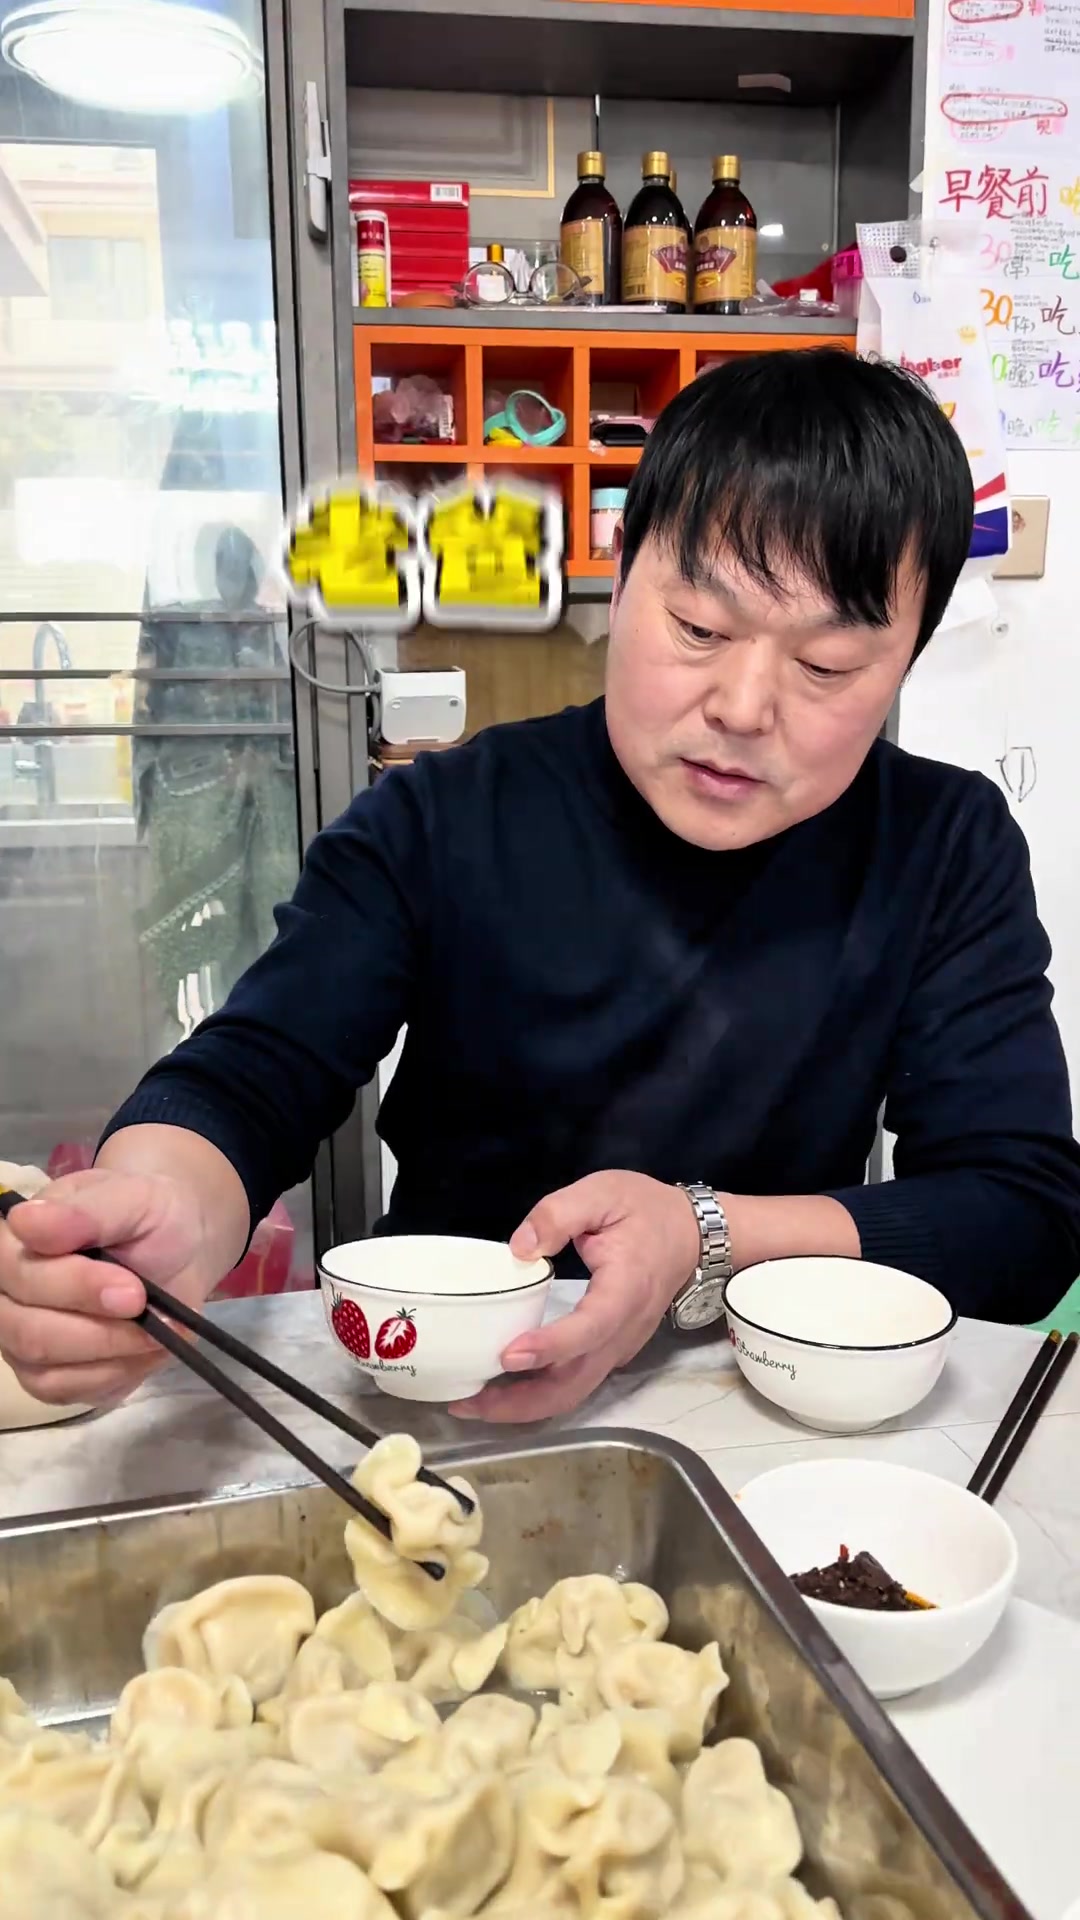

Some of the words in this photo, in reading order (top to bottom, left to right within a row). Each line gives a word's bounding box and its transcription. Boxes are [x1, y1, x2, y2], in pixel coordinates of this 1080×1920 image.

[938, 164, 1049, 220] 早餐前
[980, 288, 1013, 327] 30
[1041, 295, 1076, 335] 吃
[736, 1336, 798, 1381] Strawberry
